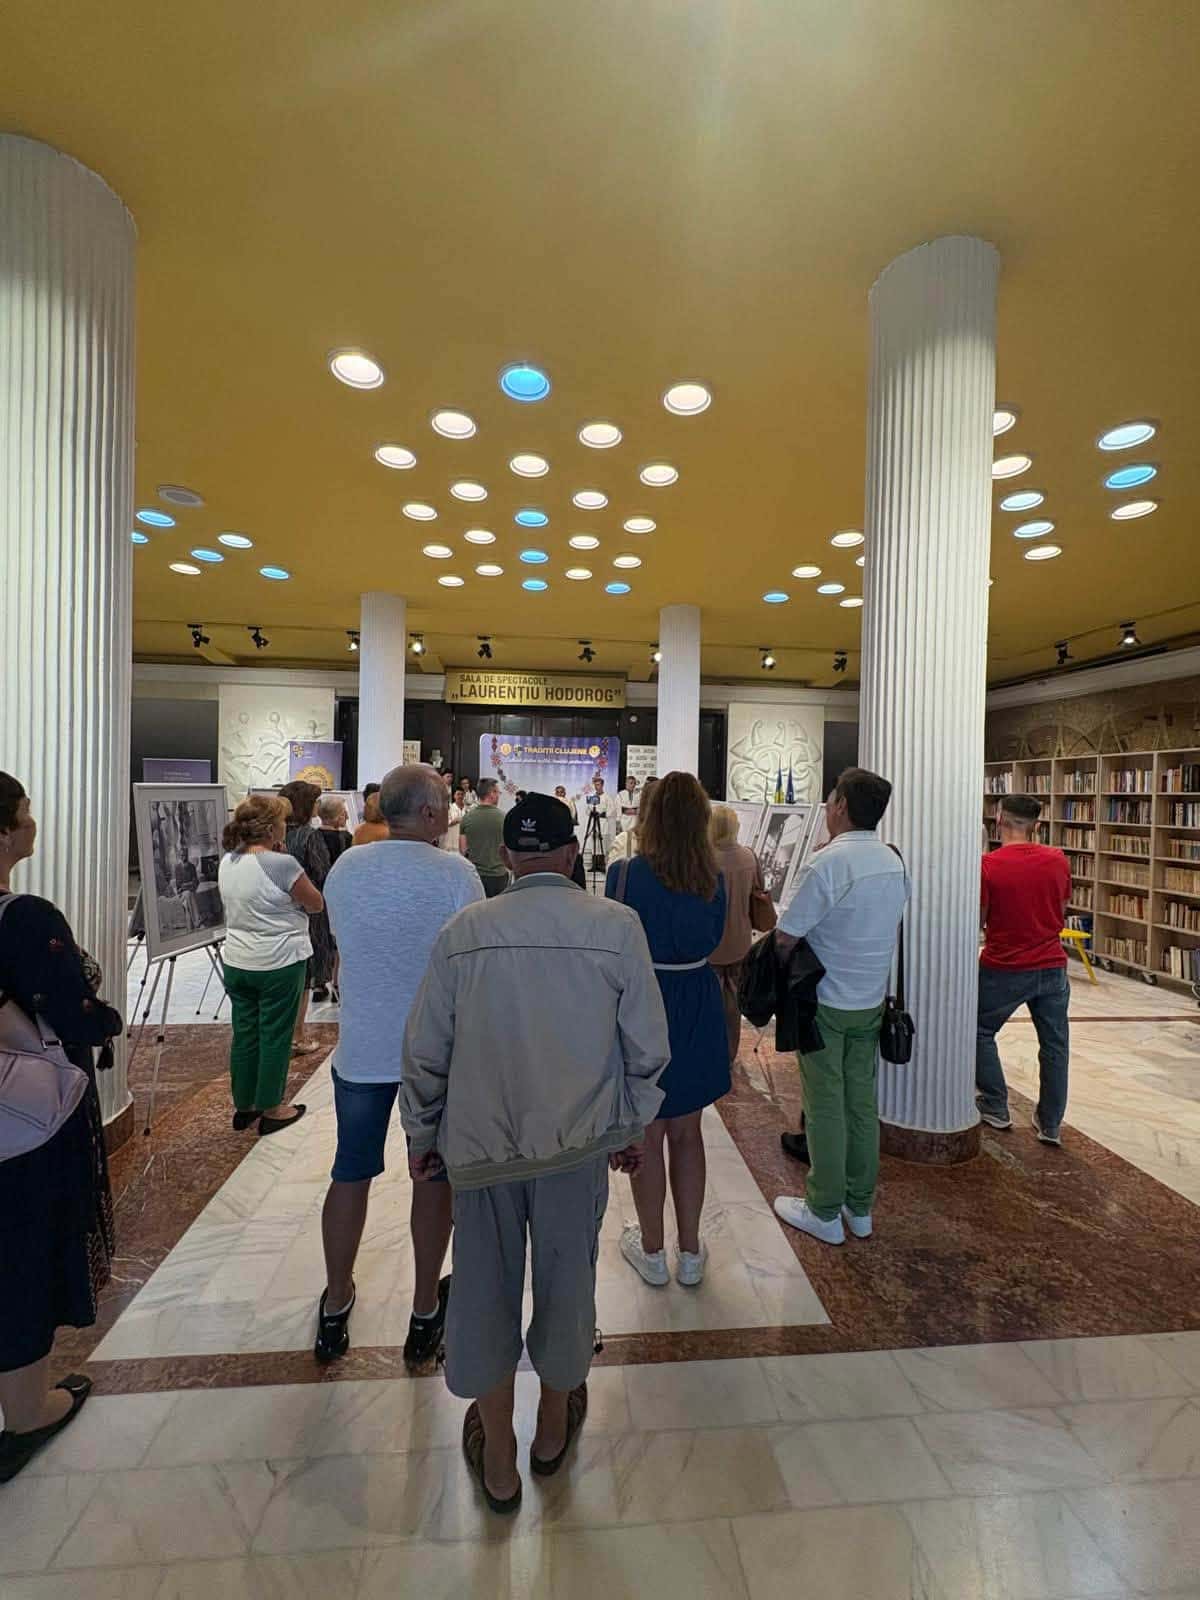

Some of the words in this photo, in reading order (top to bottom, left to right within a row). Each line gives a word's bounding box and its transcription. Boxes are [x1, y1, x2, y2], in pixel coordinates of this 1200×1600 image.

[459, 674, 481, 683] SALA
[484, 675, 494, 684] DE
[497, 675, 549, 686] SPECTACOLE
